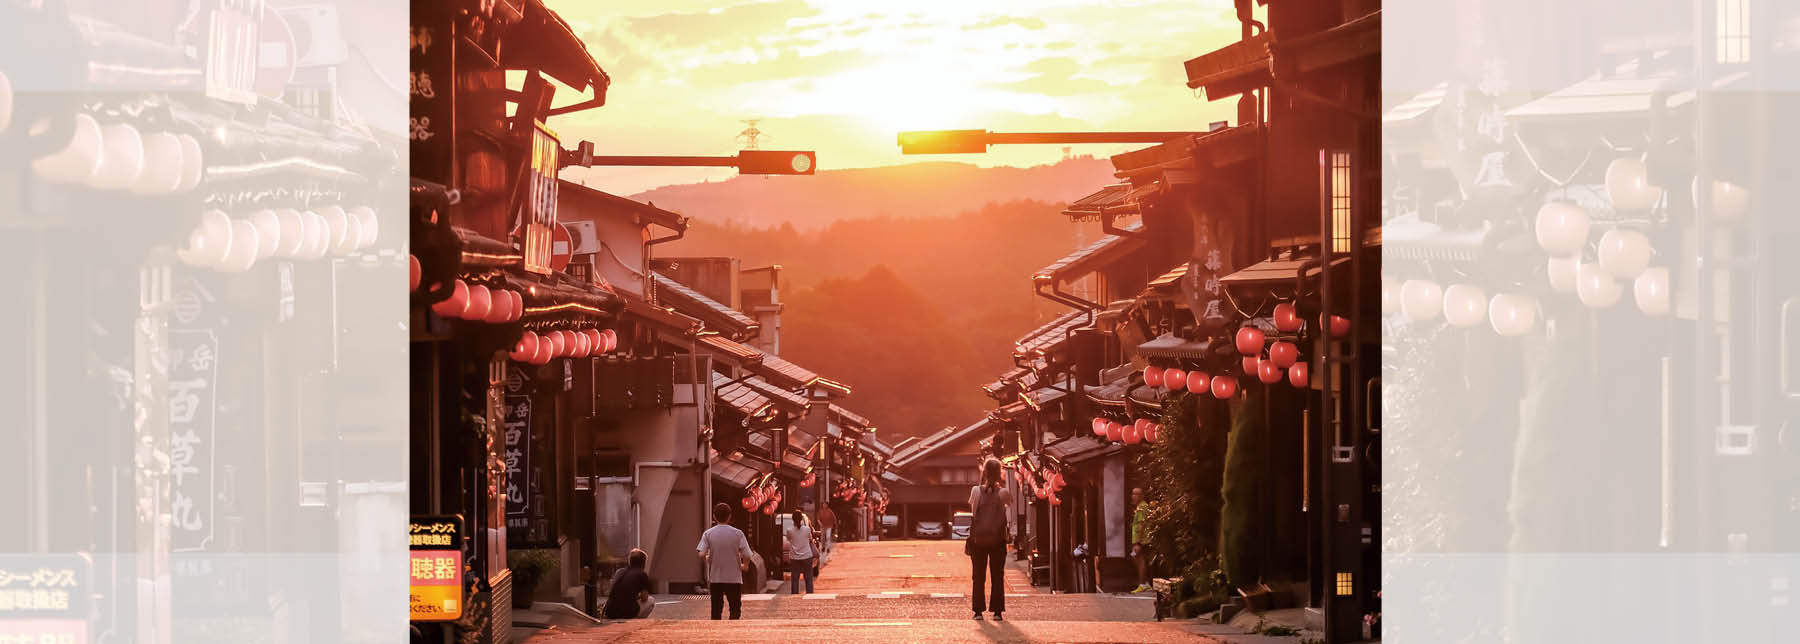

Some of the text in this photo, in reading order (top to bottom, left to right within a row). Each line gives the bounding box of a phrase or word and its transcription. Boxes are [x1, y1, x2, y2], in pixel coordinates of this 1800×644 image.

[505, 421, 526, 503] 百草丸
[411, 557, 456, 580] 聴器
